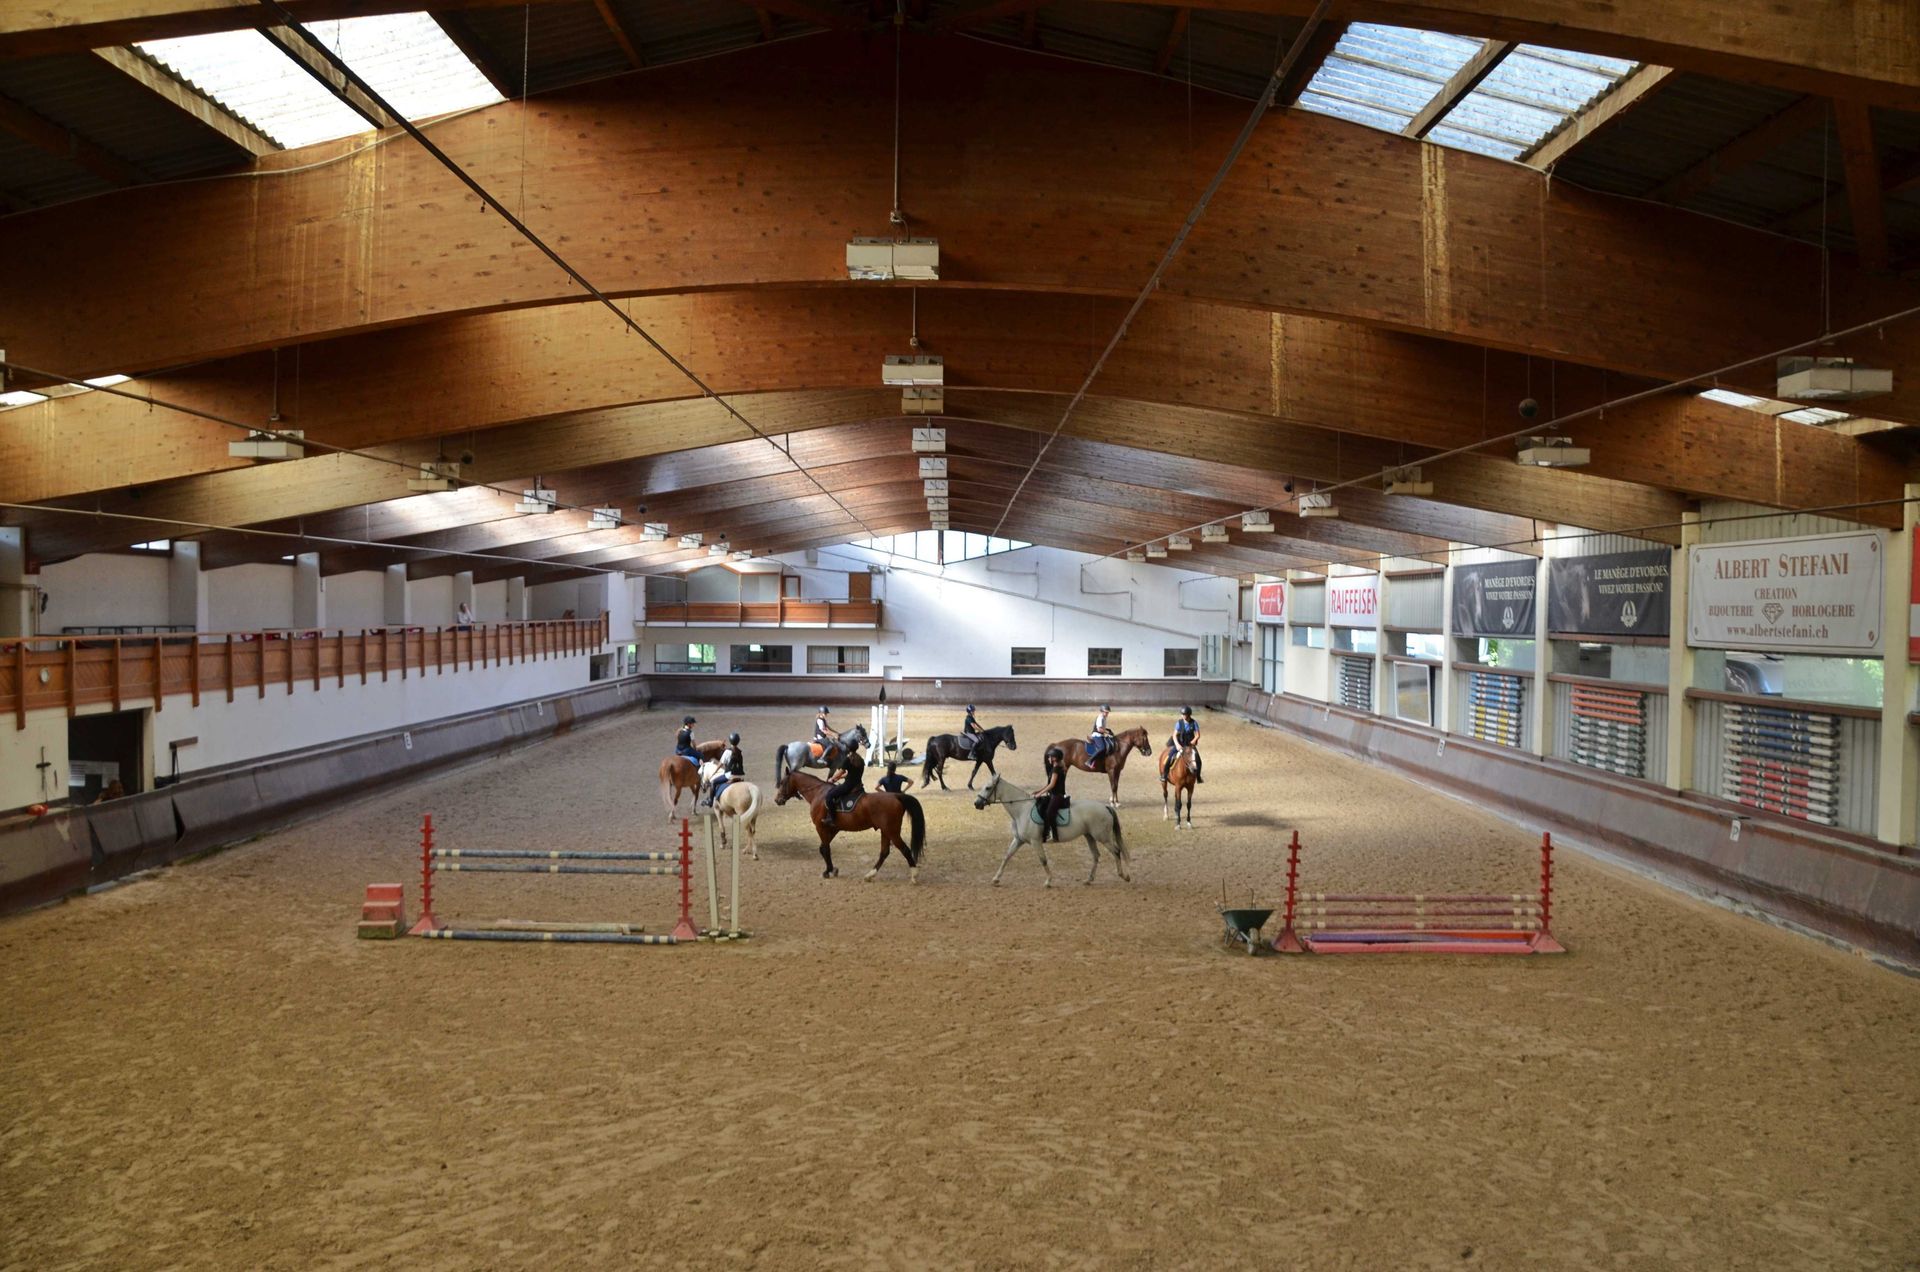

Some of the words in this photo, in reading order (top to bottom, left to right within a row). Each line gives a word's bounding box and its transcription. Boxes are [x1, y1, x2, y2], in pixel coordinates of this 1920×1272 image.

[1714, 558, 1770, 579] ALBERT
[1779, 553, 1848, 577] STEFANI
[1754, 587, 1798, 600] CREATION
[1708, 605, 1754, 617] BIJOUTERIE
[1792, 604, 1855, 617] HORLOGERIE
[1727, 624, 1829, 639] www.albertstefani.ch
